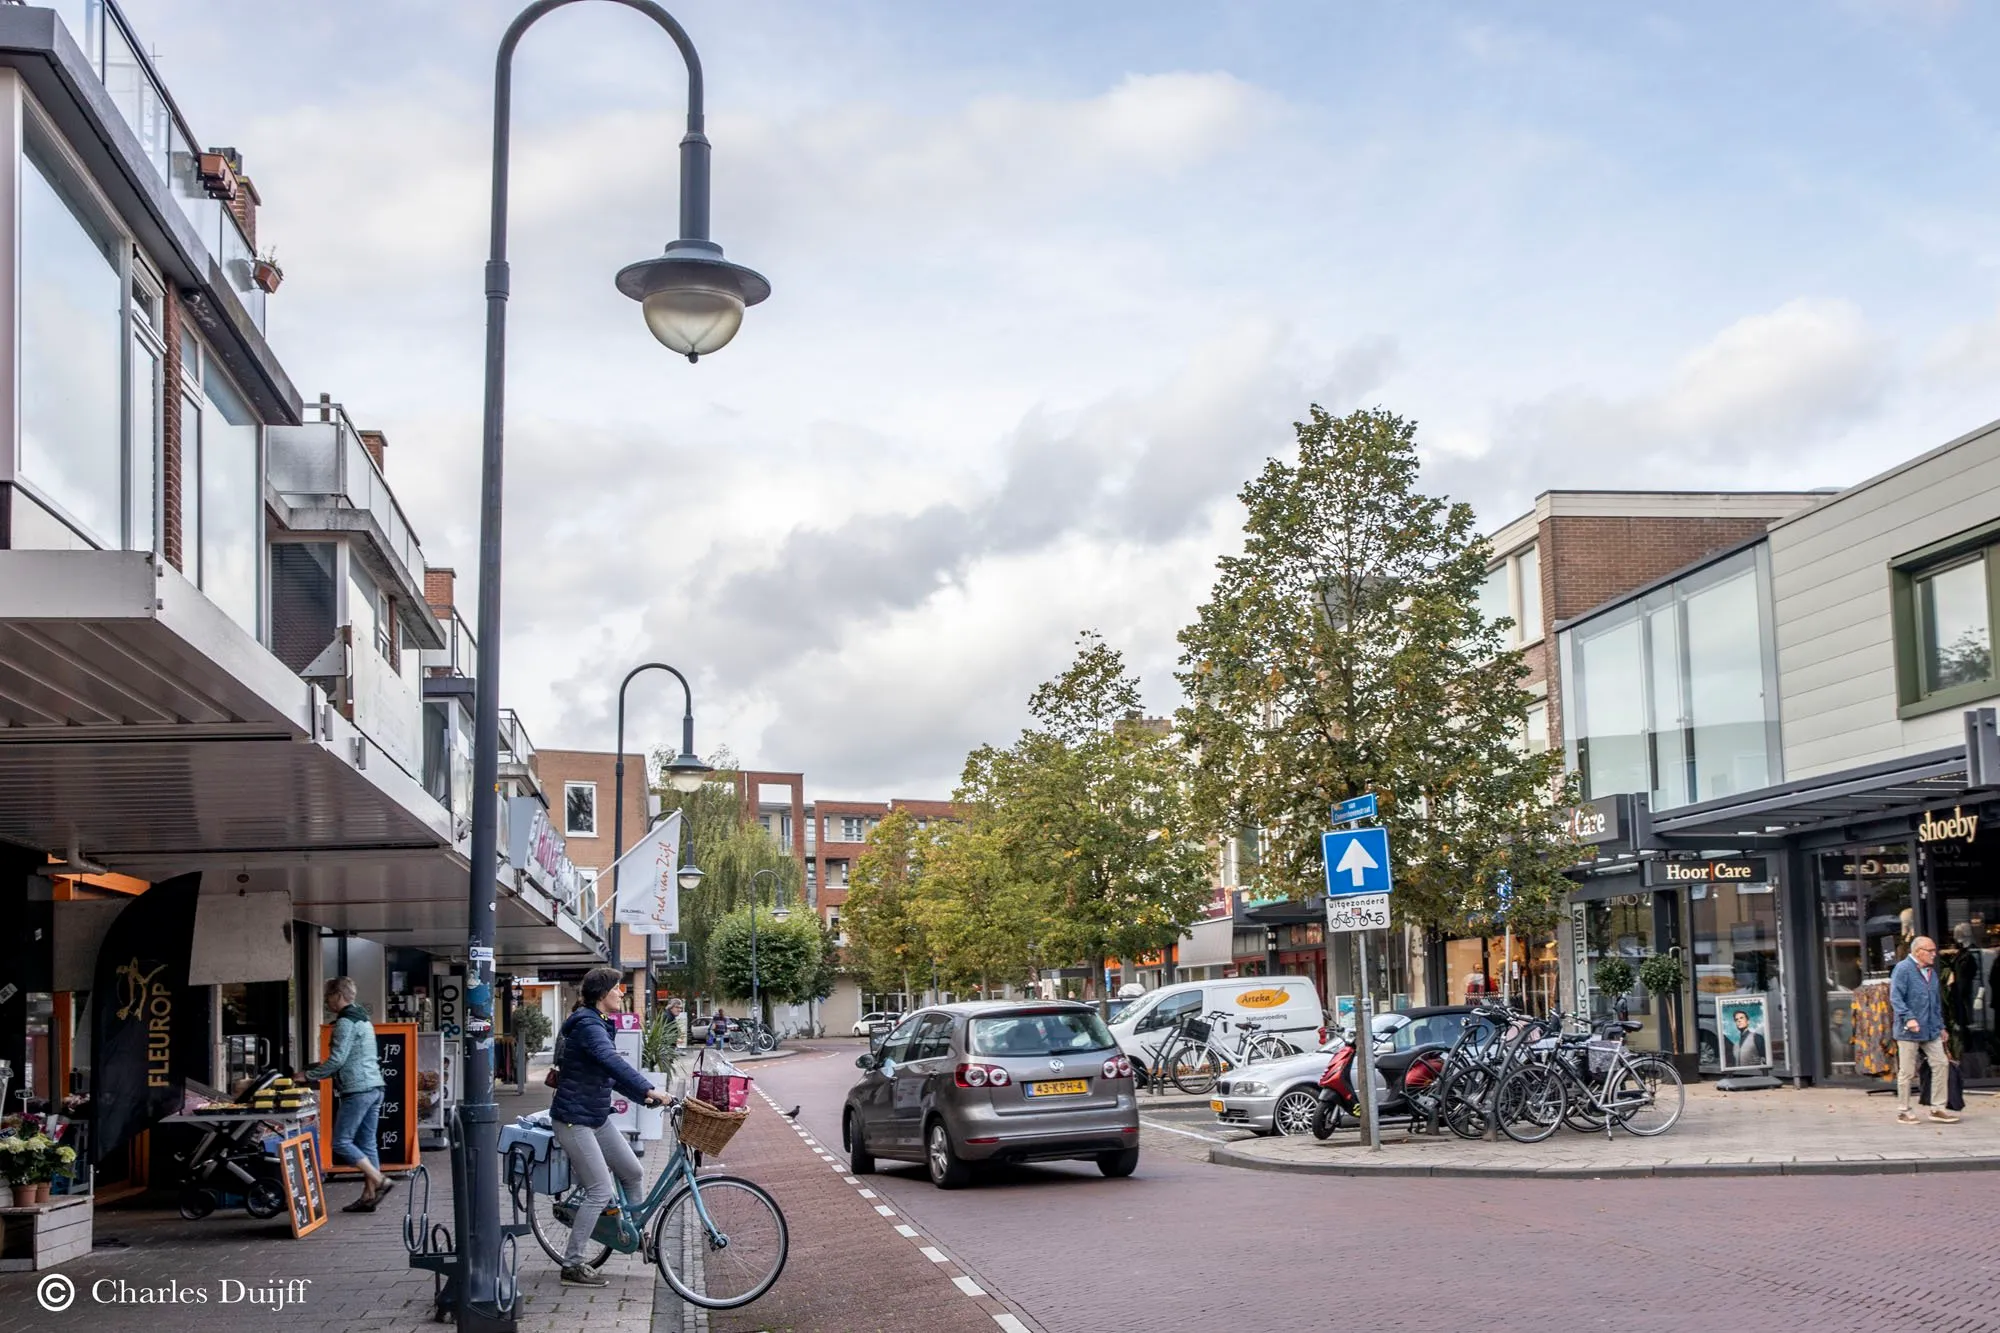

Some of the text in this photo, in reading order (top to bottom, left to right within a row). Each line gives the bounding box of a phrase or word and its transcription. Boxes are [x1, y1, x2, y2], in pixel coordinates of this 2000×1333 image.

[1918, 805, 1979, 843] shoeby
[1666, 863, 1752, 880] Hoor Care
[1329, 898, 1384, 909] uitgezonderd
[148, 983, 172, 1087] FLEUROP
[1036, 1080, 1084, 1094] 43-KPH-4
